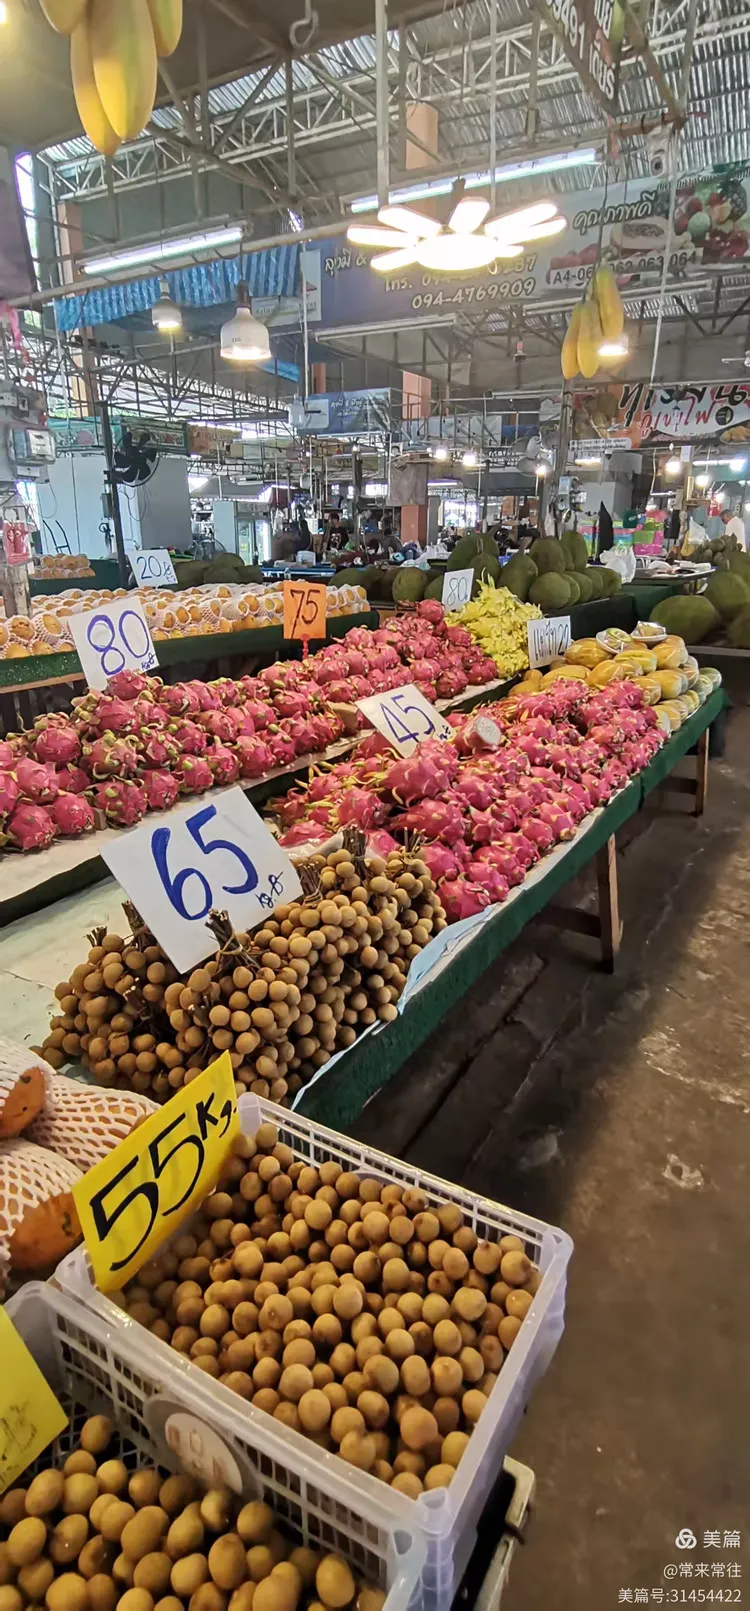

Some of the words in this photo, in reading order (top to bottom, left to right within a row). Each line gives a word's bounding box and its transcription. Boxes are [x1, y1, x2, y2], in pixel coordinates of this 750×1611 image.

[574, 190, 657, 235] คุณภาพดี
[356, 251, 367, 266] &
[412, 277, 537, 309] 094-4769909
[137, 556, 162, 579] 20
[290, 589, 321, 639] 75
[447, 576, 468, 607] 80
[87, 610, 150, 676] 80
[380, 694, 436, 743] 45
[151, 804, 259, 921] 65
[89, 1112, 205, 1271] 55
